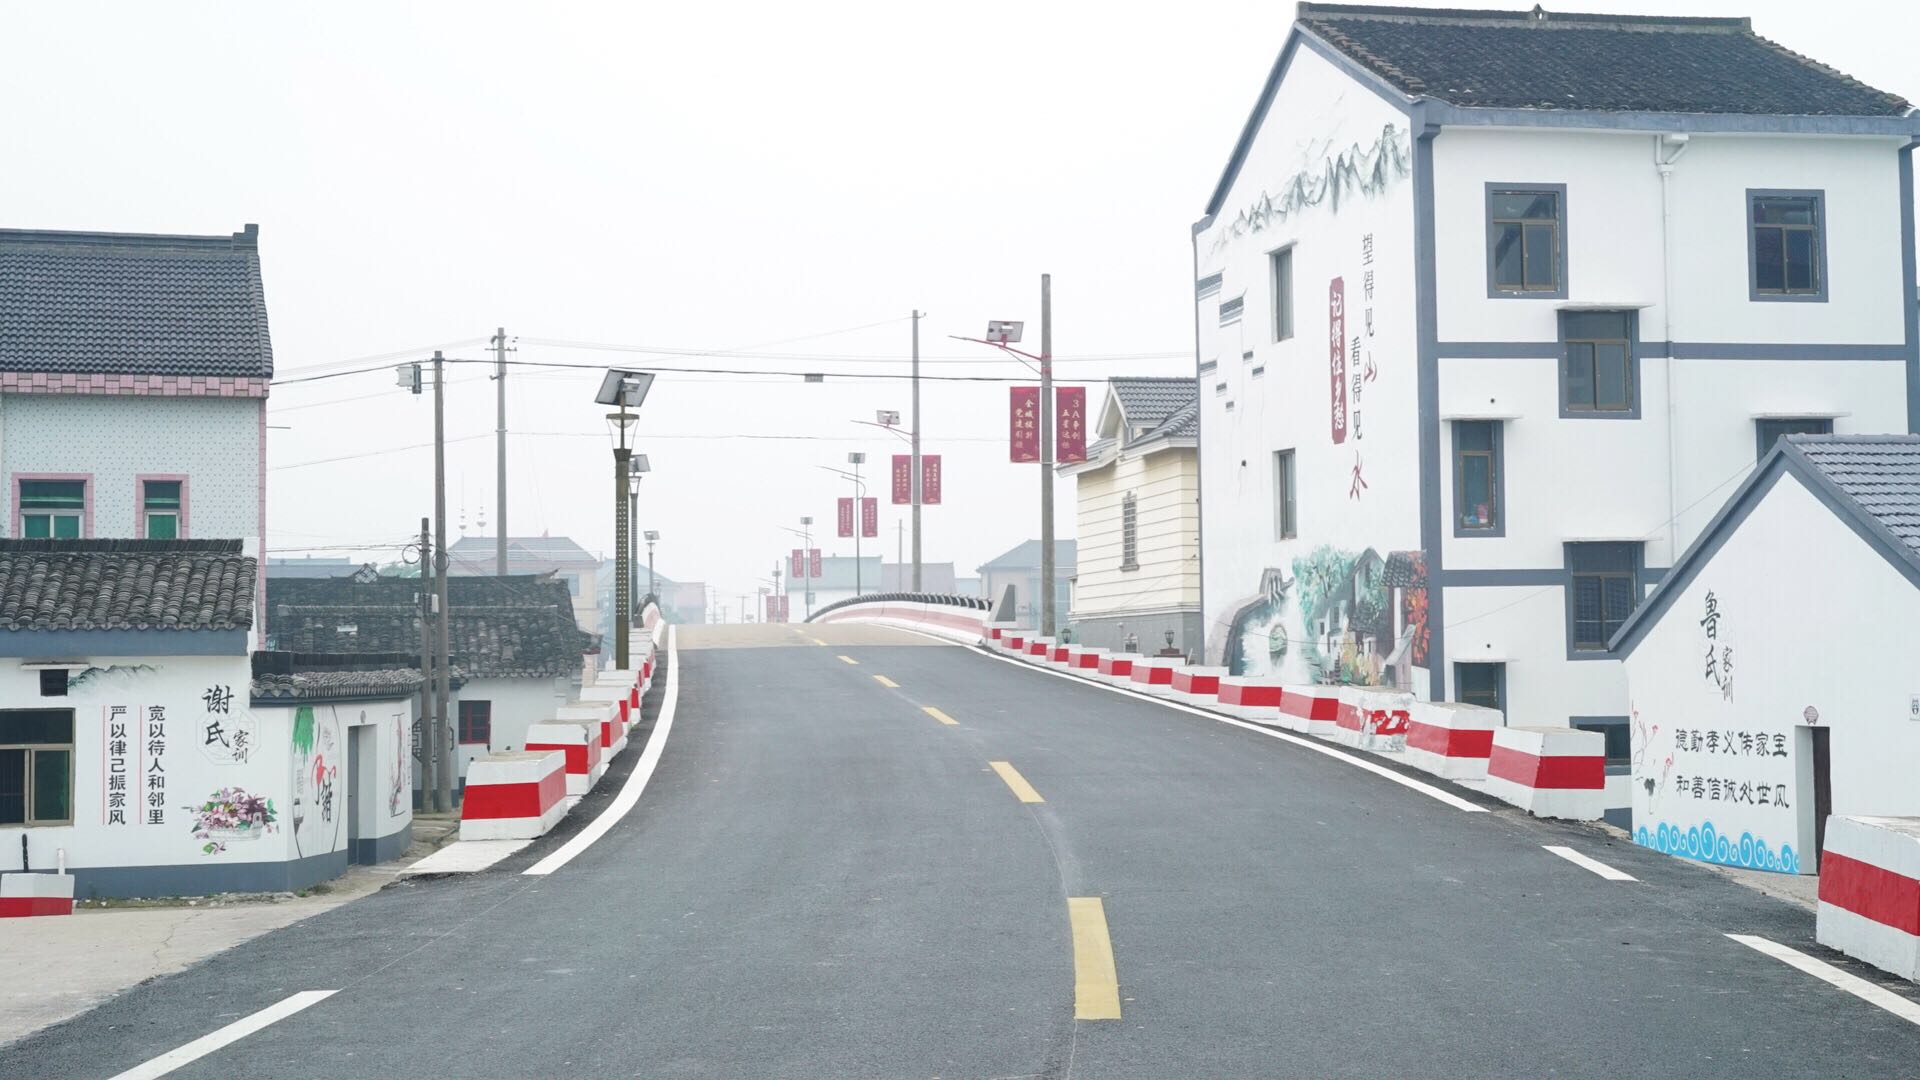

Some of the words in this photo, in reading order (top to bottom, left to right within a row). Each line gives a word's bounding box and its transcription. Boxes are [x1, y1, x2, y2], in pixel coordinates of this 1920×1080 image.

[1362, 233, 1377, 384] 望得见山
[1349, 336, 1368, 502] 看得见水
[1700, 589, 1722, 687] 鲁氏
[1721, 645, 1734, 704] 家训
[147, 705, 167, 825] 宽以待人和邻里
[202, 684, 234, 748] 谢氏
[231, 729, 250, 765] 家训
[108, 705, 127, 826] 严以律己振家风
[1675, 775, 1790, 809] 和善信诚处世风
